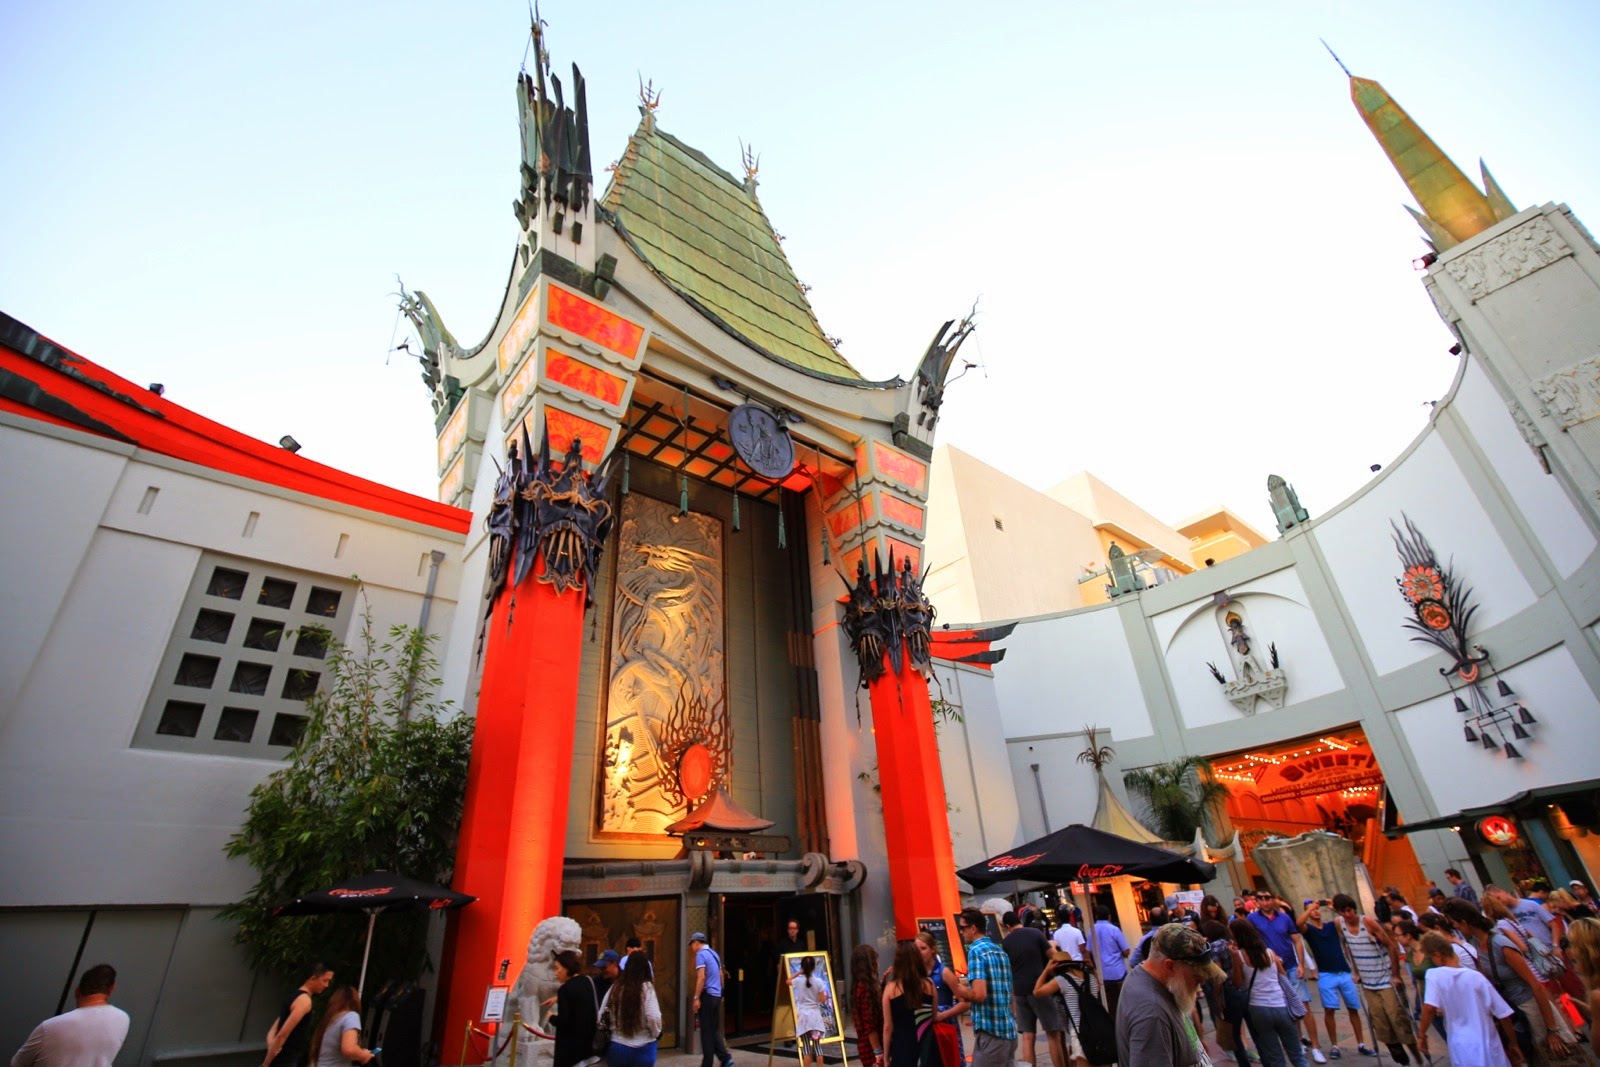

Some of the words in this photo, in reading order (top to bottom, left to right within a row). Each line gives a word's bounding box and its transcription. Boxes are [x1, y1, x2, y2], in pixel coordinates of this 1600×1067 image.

[1302, 779, 1325, 788] CANDY
[1262, 791, 1296, 802] SOUVENIRS
[1300, 784, 1337, 795] CHOCOLATE
